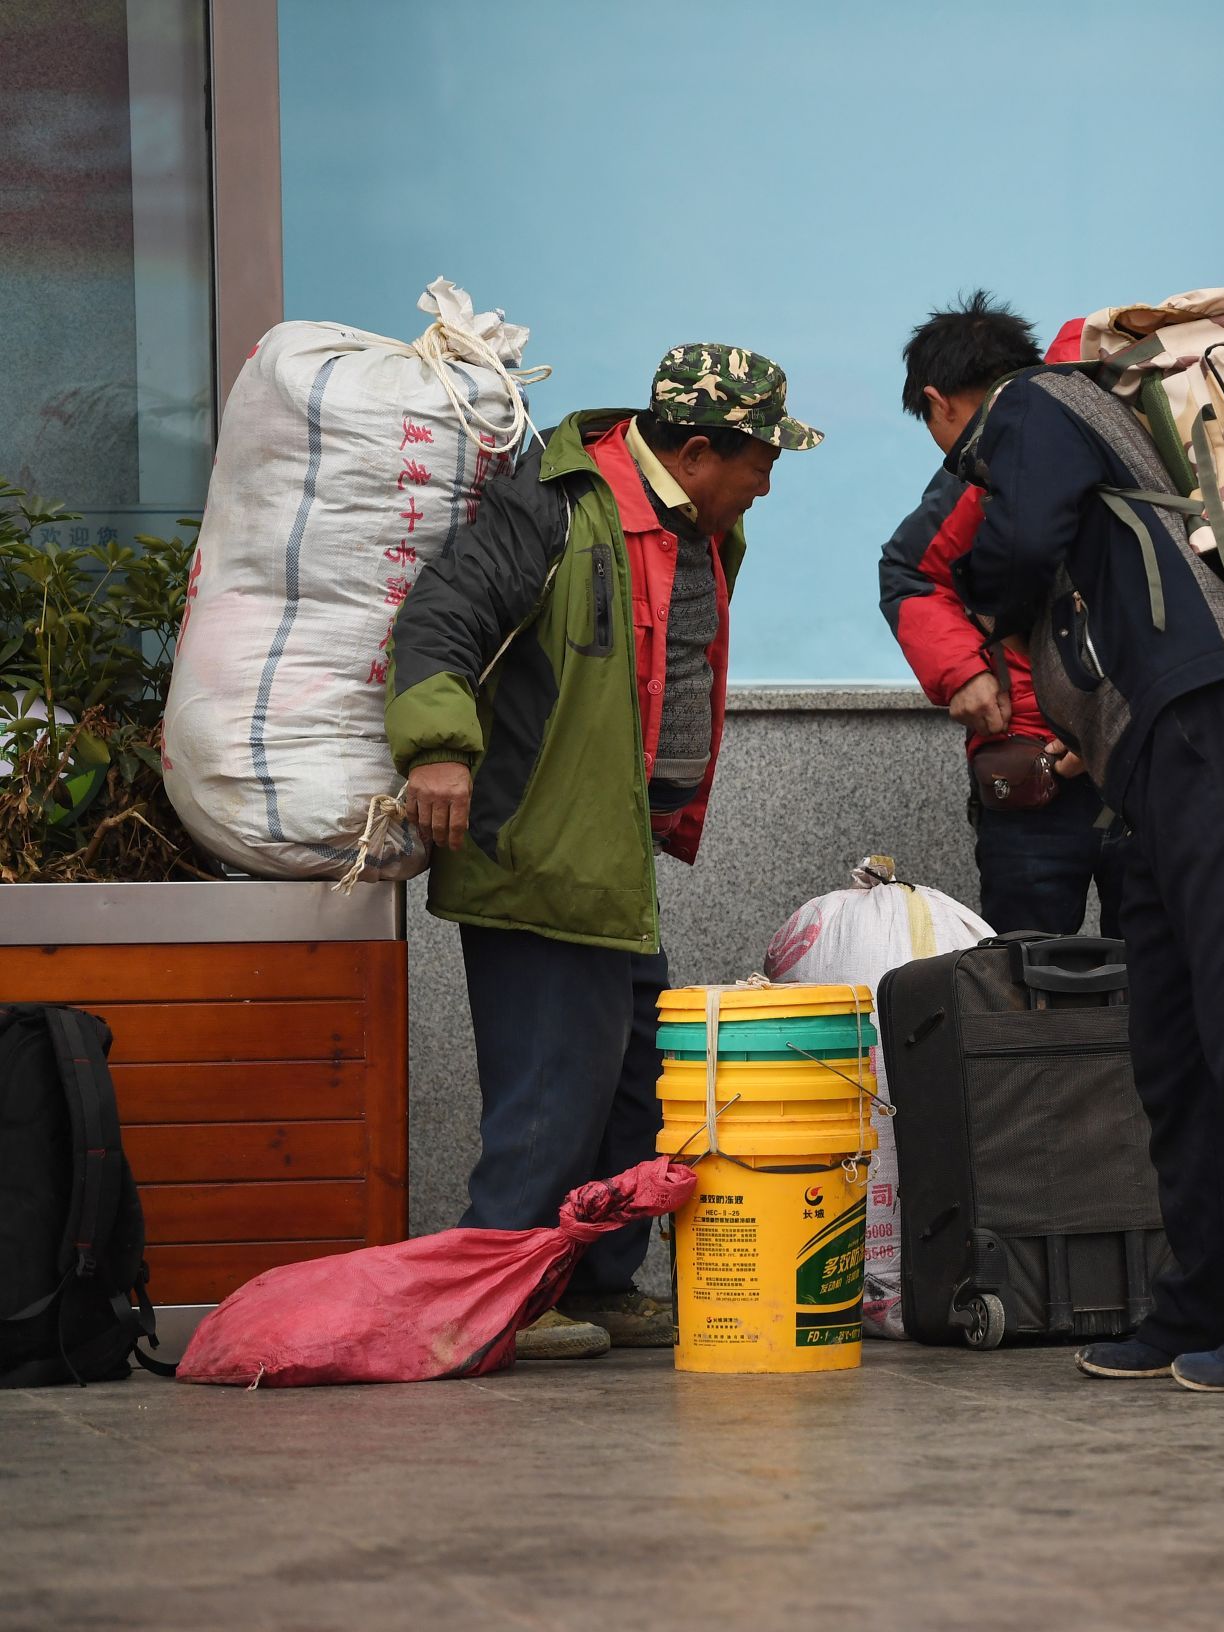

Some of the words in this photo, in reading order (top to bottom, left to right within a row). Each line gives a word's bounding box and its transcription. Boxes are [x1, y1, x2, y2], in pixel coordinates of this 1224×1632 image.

[27, 526, 118, 548] 欢迎您
[872, 1183, 893, 1207] 司
[803, 1209, 825, 1219] 长城
